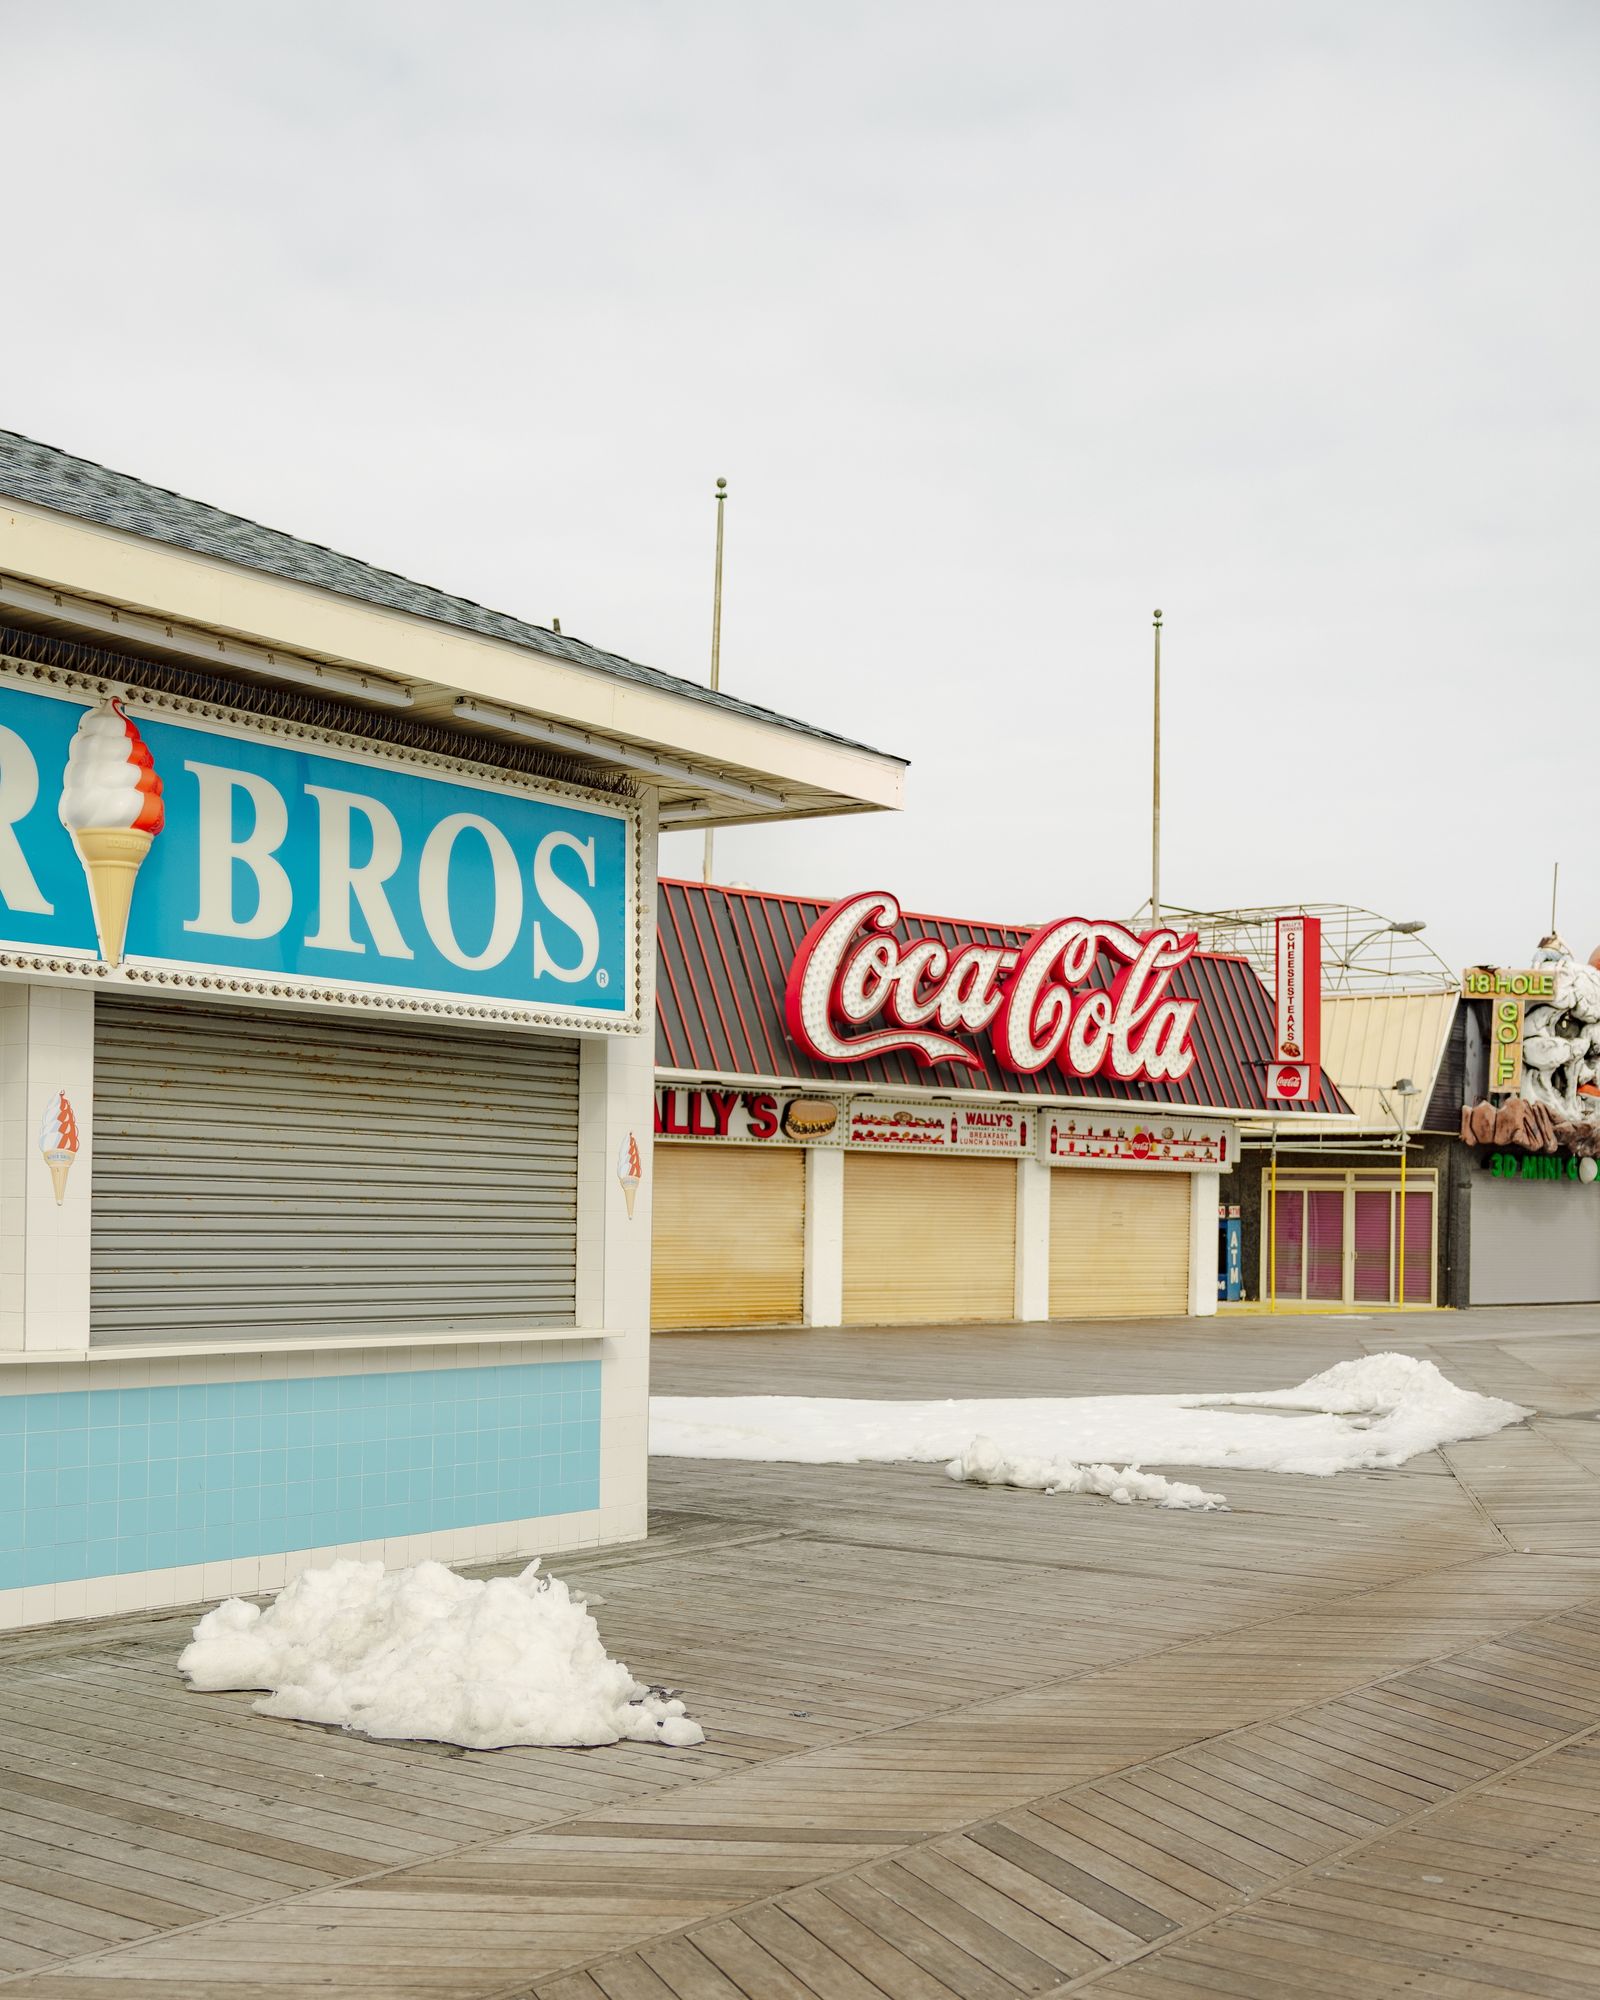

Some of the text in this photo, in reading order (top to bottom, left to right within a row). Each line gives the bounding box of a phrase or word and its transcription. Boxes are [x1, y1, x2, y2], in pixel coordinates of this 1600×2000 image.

[183, 760, 600, 983] BROS
[786, 891, 1199, 1083] Coca-Cola
[1287, 932, 1295, 1041] CHEESESTEAKS
[1467, 973, 1554, 995] 18 HOLE
[1497, 1001, 1519, 1086] GOLF
[654, 1089, 779, 1139] LLY'S
[965, 1112, 1013, 1127] WALLY'S
[969, 1131, 1009, 1140] BREAKFAST
[1490, 1152, 1517, 1178] 3D
[1522, 1155, 1562, 1180] MINI
[1230, 1231, 1239, 1284] ATM
